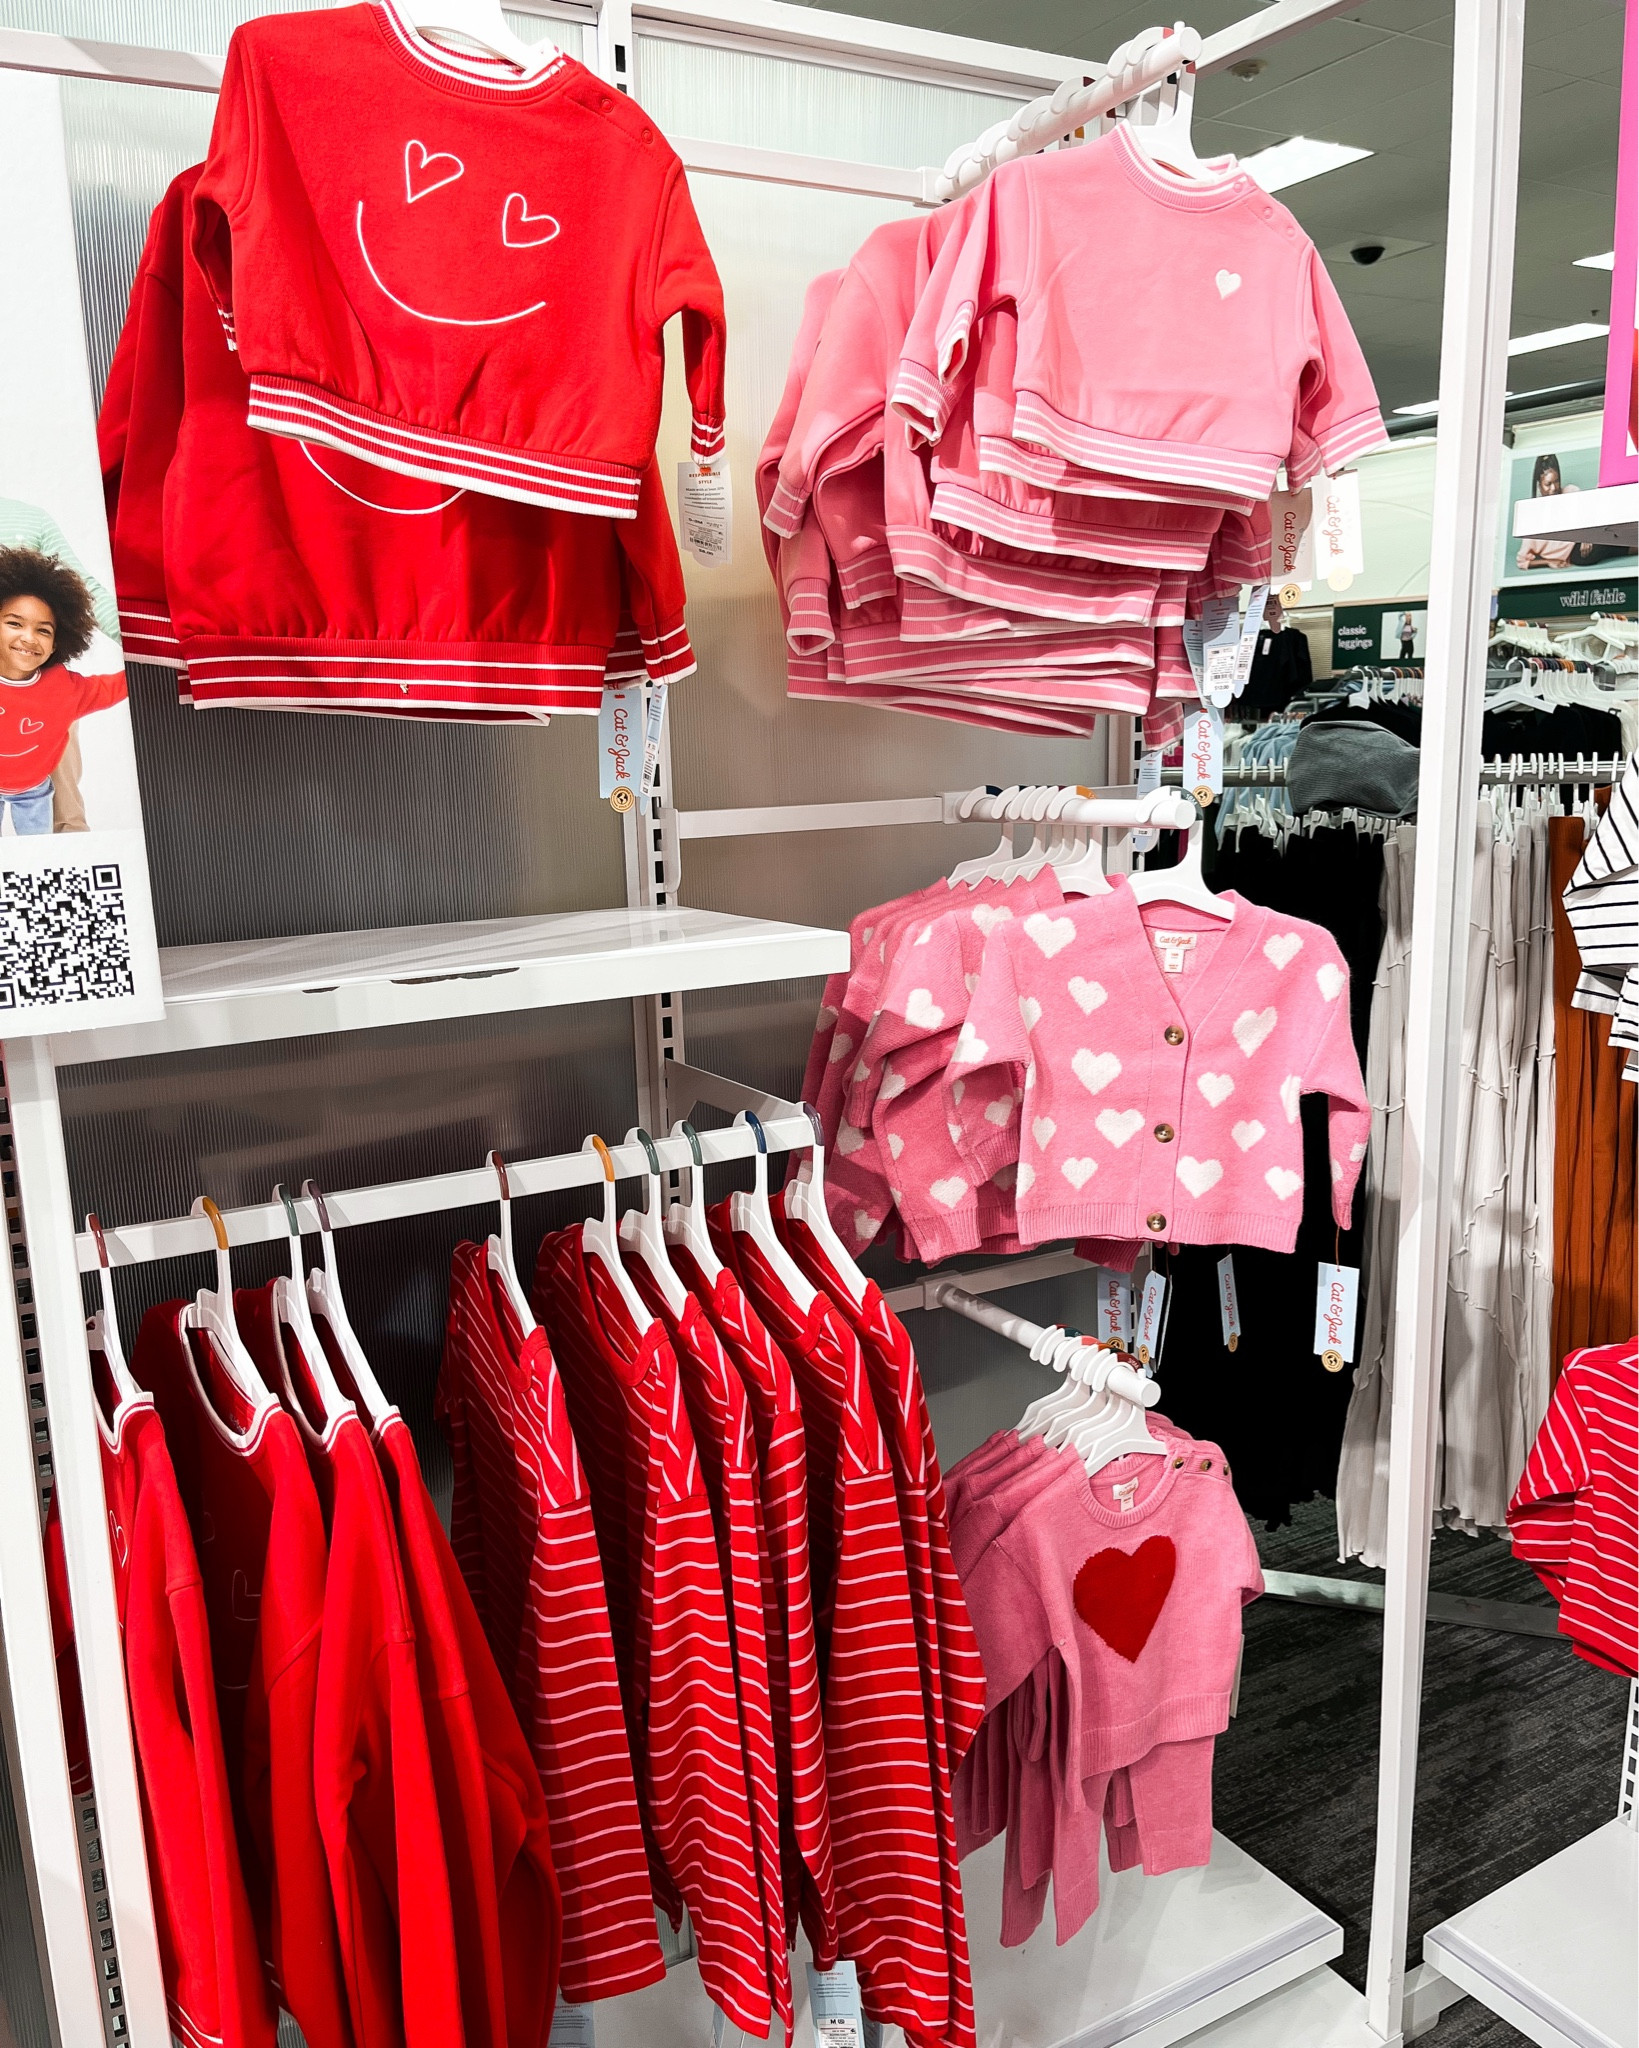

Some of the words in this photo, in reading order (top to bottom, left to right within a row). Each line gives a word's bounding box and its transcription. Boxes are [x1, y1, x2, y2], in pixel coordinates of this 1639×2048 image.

[1326, 495, 1340, 516] Cat
[1284, 511, 1296, 532] Cat
[1284, 533, 1296, 544] &
[1322, 529, 1344, 557] Jack
[1278, 545, 1296, 573] Jack
[1560, 589, 1589, 607] wild
[1590, 588, 1626, 606] fable
[1338, 625, 1367, 636] classic
[1338, 638, 1373, 650] leggings
[613, 708, 628, 732] Cat
[1197, 719, 1212, 739] Cat
[614, 733, 629, 747] &
[1198, 742, 1211, 753] &
[607, 747, 631, 781] Jack
[1191, 752, 1212, 781] Jack
[1108, 1280, 1120, 1298] Cat
[1331, 1282, 1345, 1302] Cat
[1109, 1299, 1120, 1309] &
[1330, 1304, 1343, 1317] &
[1104, 1308, 1122, 1333] Jack
[1323, 1314, 1343, 1344] Jack
